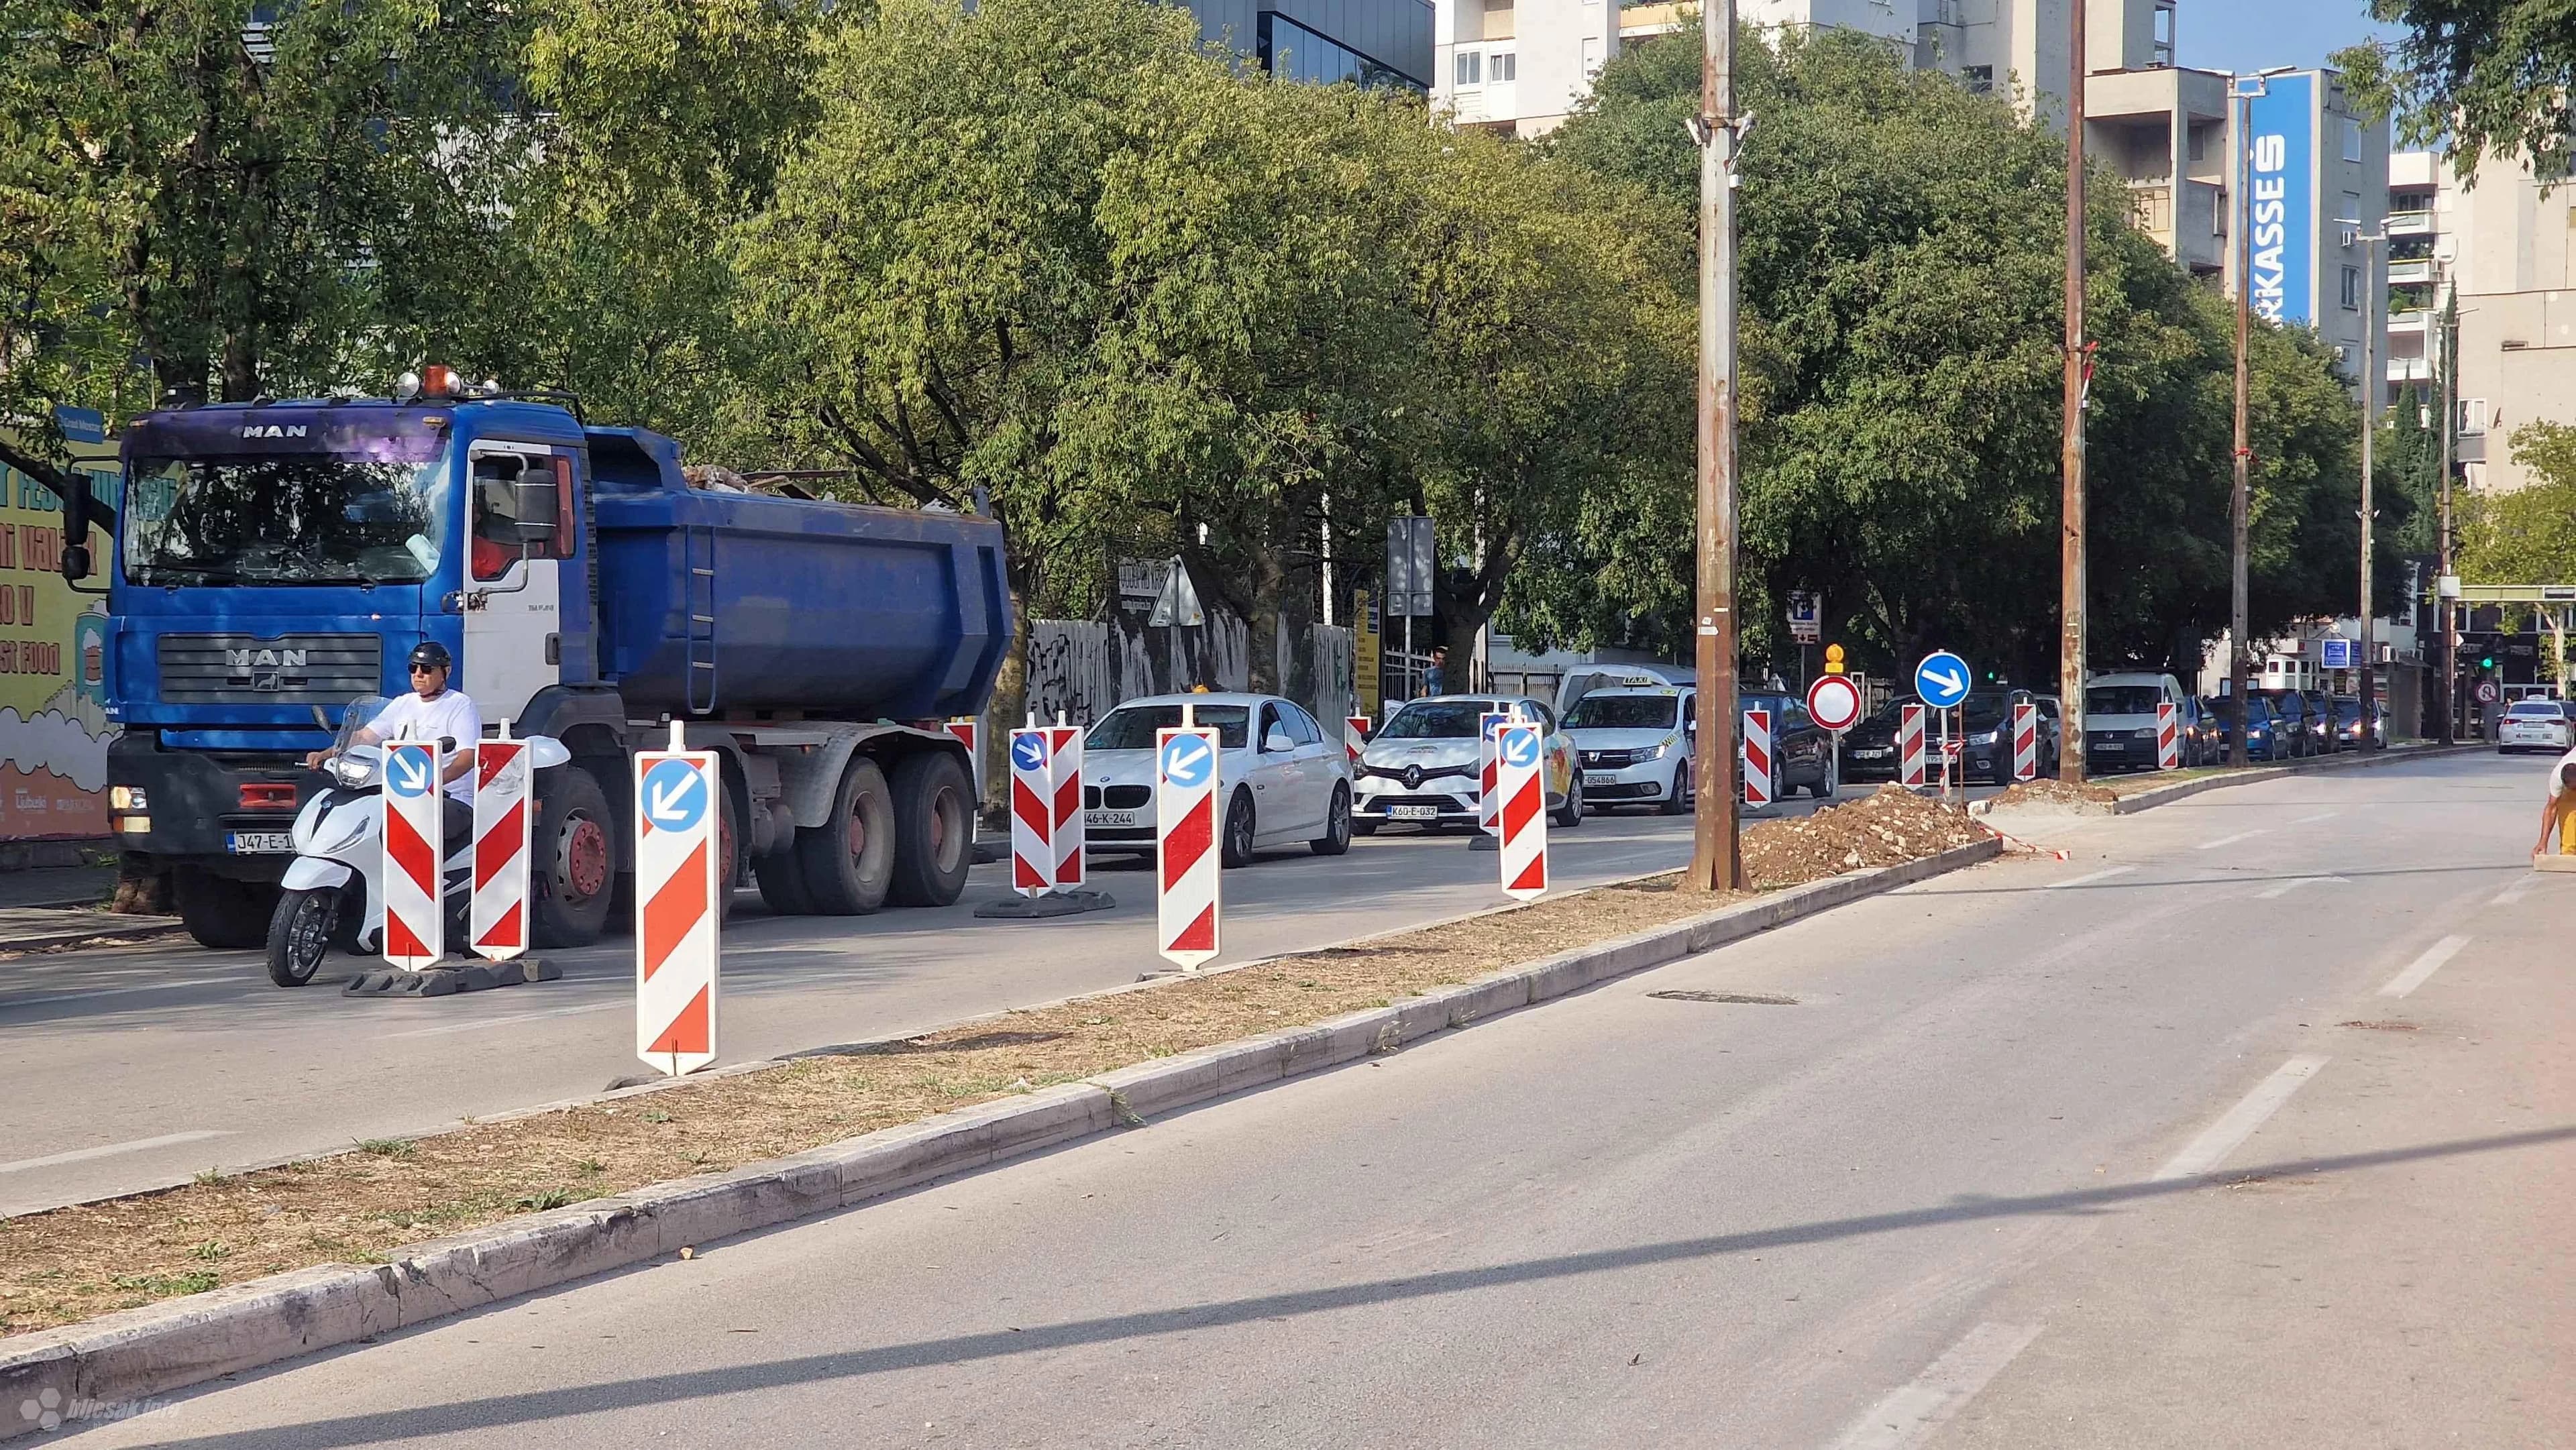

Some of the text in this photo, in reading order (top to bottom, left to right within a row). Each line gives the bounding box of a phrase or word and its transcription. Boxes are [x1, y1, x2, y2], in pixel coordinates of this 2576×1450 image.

[243, 425, 307, 438] MAN
[225, 649, 307, 666] MAN
[1085, 813, 1132, 824] 46-K-244
[237, 834, 292, 849] J47-E-1
